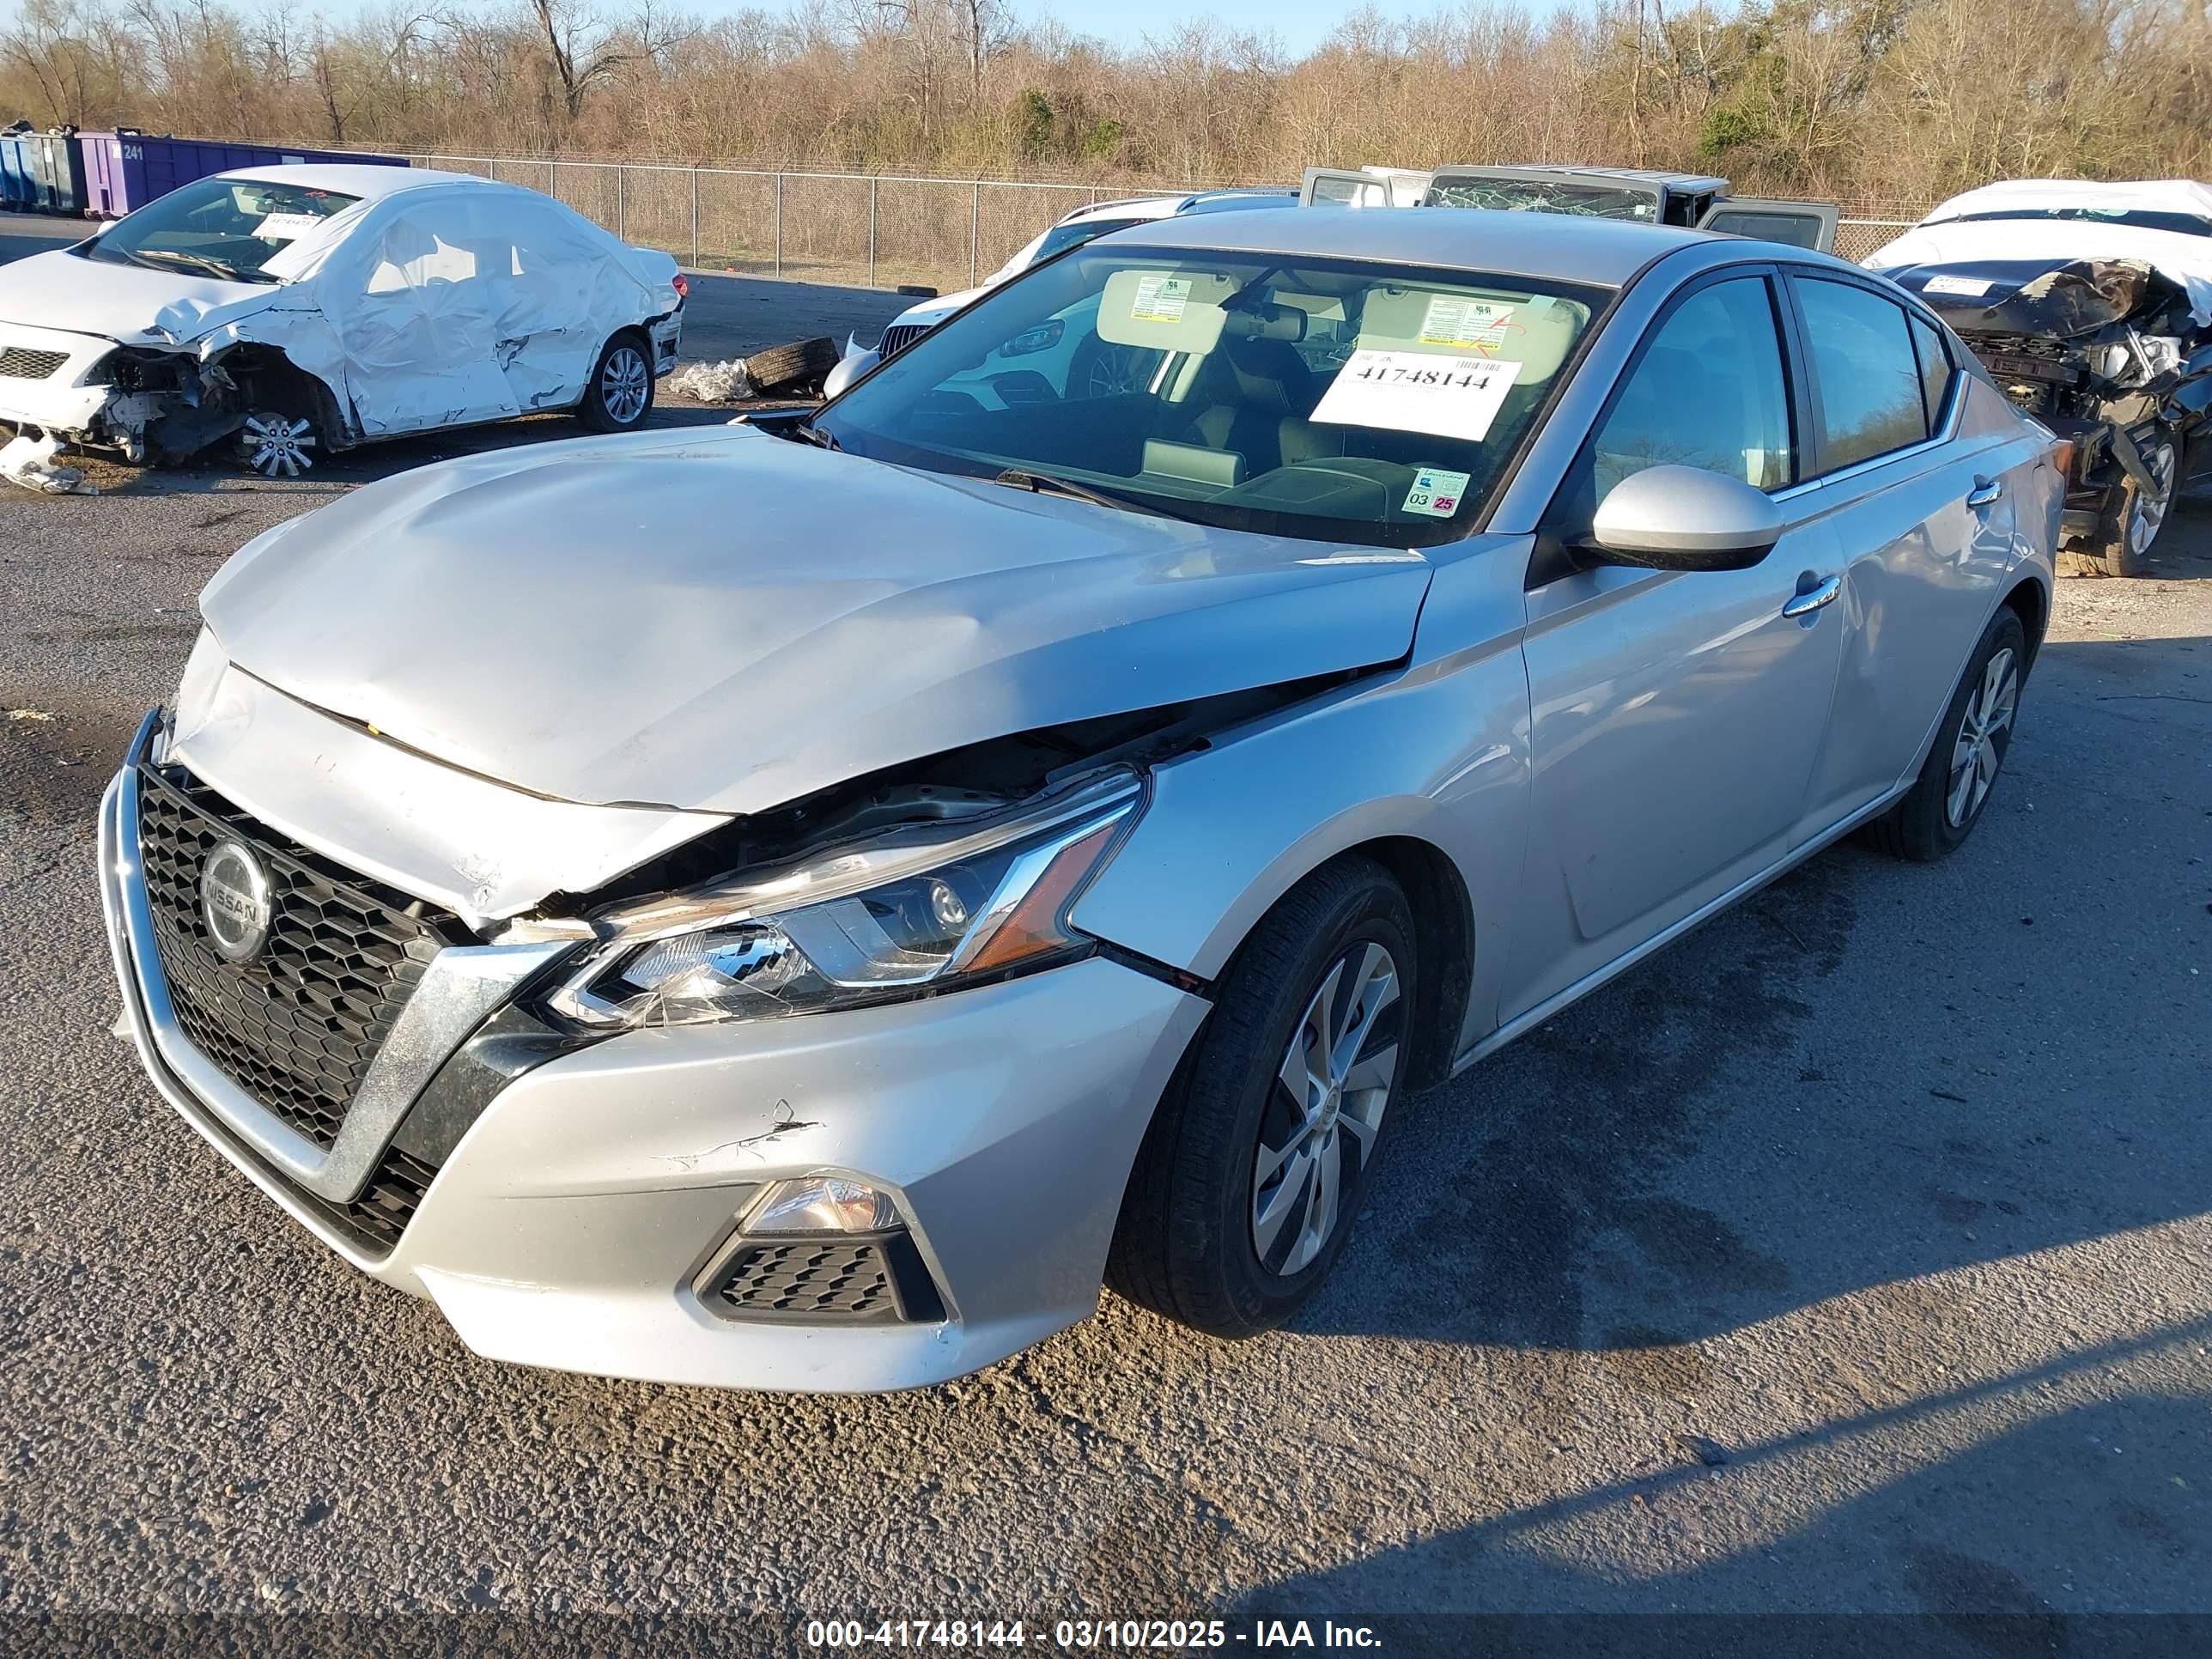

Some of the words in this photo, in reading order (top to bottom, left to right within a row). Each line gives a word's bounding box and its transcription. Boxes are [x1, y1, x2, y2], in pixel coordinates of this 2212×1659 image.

[124, 144, 143, 161] 241
[1357, 366, 1491, 390] 41748144
[1409, 493, 1429, 505] 03
[1434, 497, 1454, 510] 25
[206, 880, 257, 922] NISSAN
